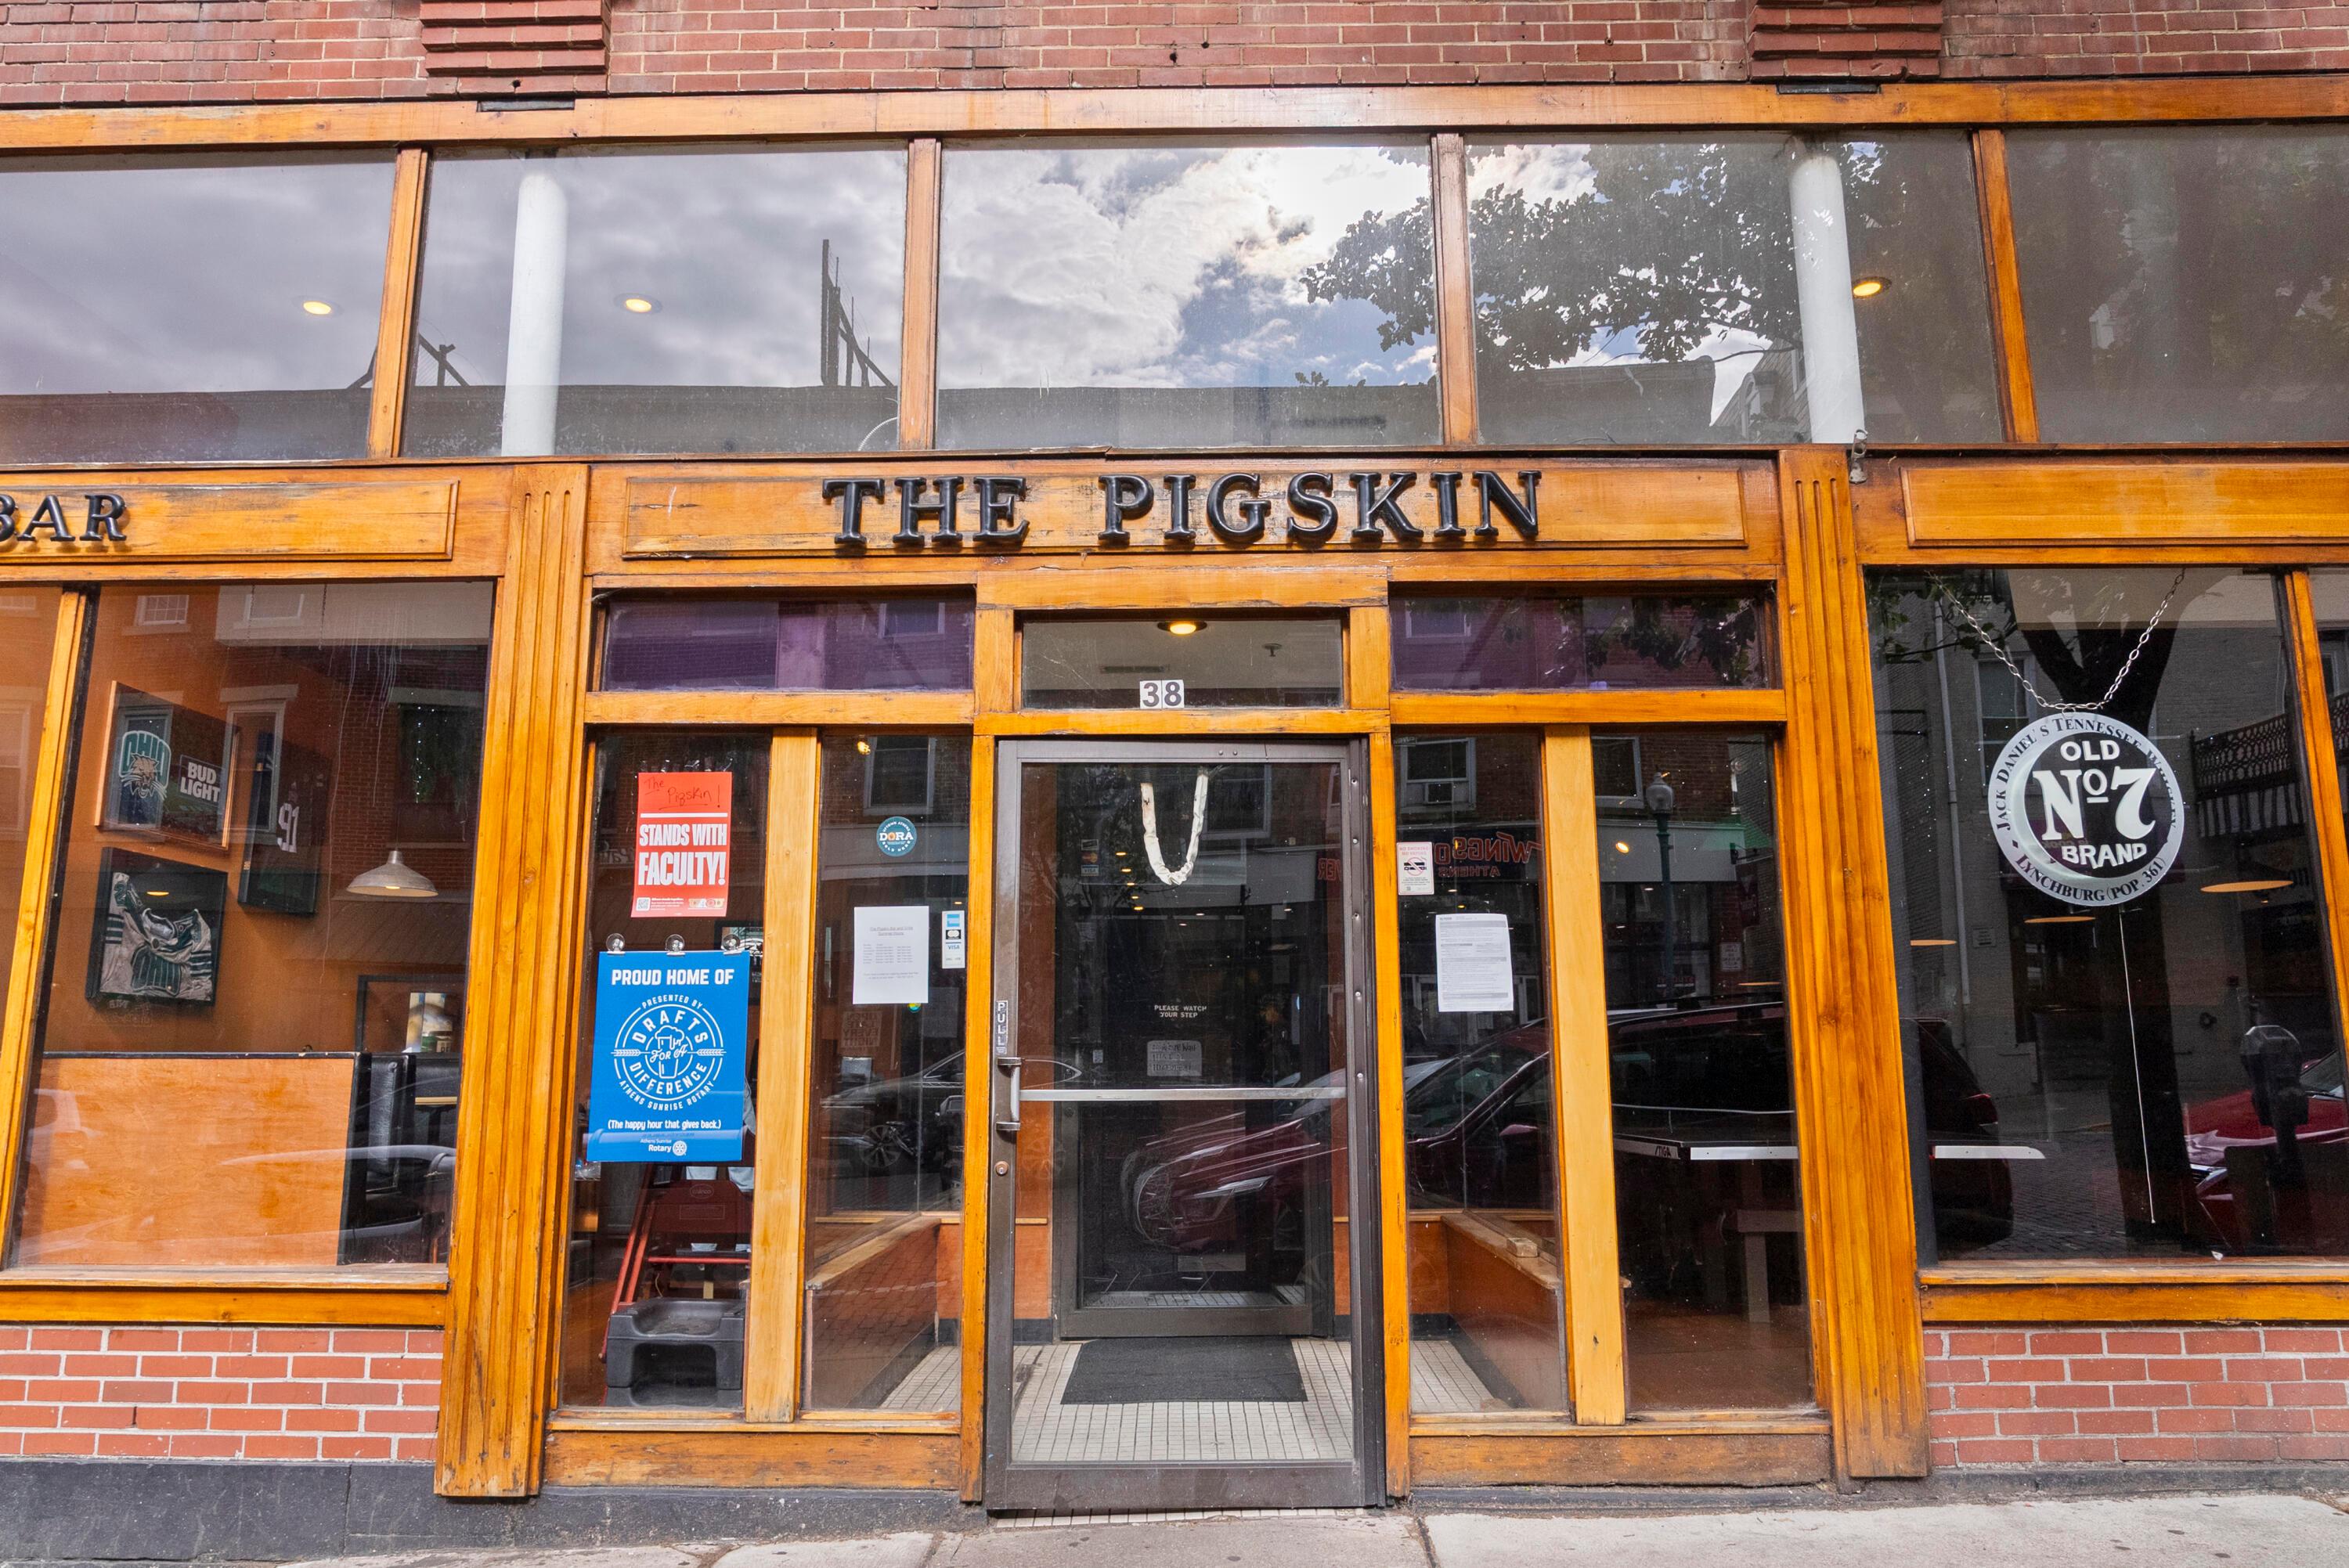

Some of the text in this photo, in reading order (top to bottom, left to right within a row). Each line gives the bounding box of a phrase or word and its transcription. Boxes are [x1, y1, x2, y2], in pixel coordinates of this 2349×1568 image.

[822, 470, 1543, 546] THE PIGSKIN
[1142, 681, 1182, 708] 38
[2060, 739, 2120, 762] OLD
[187, 762, 217, 784] BUD
[644, 776, 665, 790] The
[180, 777, 221, 802] LIGHT
[1994, 788, 2012, 831] JACK
[277, 802, 300, 853] 91
[639, 824, 727, 846] STANDS WITH
[879, 831, 914, 842] DORA
[638, 851, 727, 886] FACULTY!
[2062, 843, 2148, 869] BRAND
[2015, 854, 2105, 902] LYNCHBURG
[612, 969, 662, 986] PROUD
[666, 969, 710, 986] HOME
[714, 968, 735, 985] OF
[641, 994, 703, 1010] PRESENTED BY
[632, 1009, 709, 1044] DRAFTS
[997, 1002, 1006, 1047] PULL
[673, 1044, 689, 1058] A
[629, 1062, 708, 1095] DIFFERENCE
[619, 1080, 715, 1112] ATHENS SUNRISE ROTARY
[608, 1119, 721, 1130] (The happy hour that gives back.)
[648, 1144, 672, 1153] Rotary
